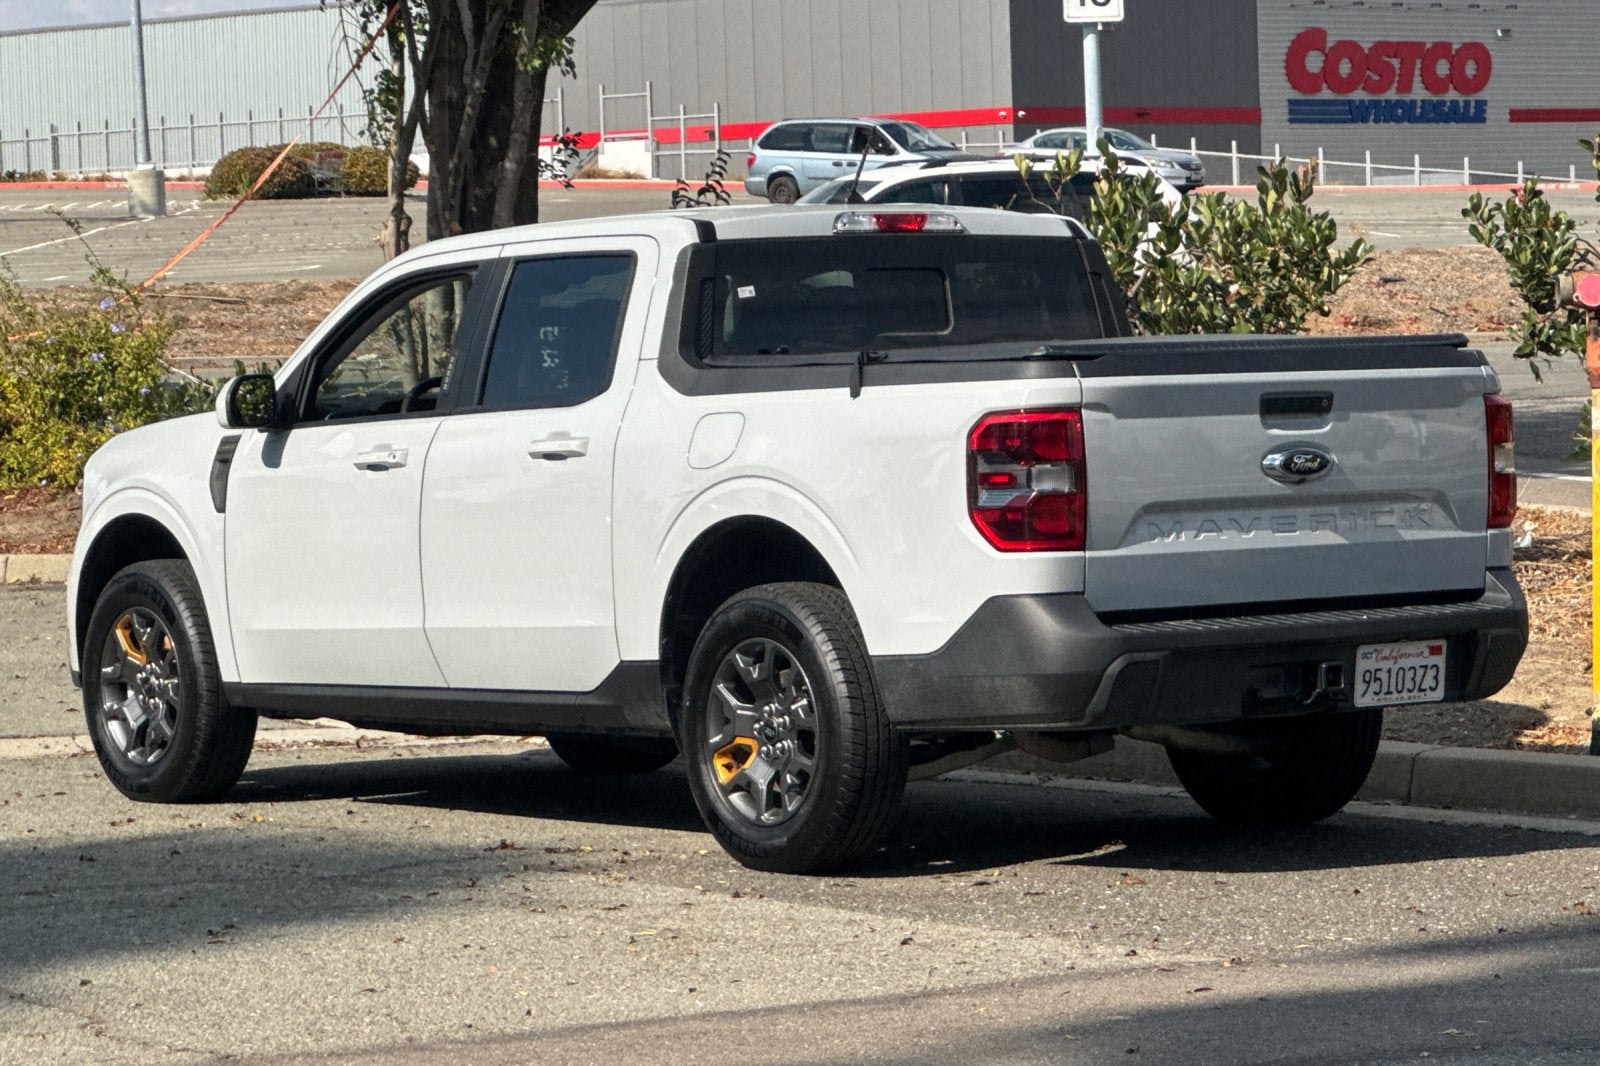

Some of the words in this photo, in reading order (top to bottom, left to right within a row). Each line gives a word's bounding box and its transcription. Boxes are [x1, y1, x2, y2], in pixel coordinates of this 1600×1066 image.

[1285, 26, 1492, 95] COSTCO
[1349, 98, 1487, 124] WHOLESALE
[1291, 454, 1320, 473] Ford
[1149, 503, 1433, 542] MAVERICK
[1373, 647, 1428, 665] California
[1361, 664, 1440, 698] 95103Z3
